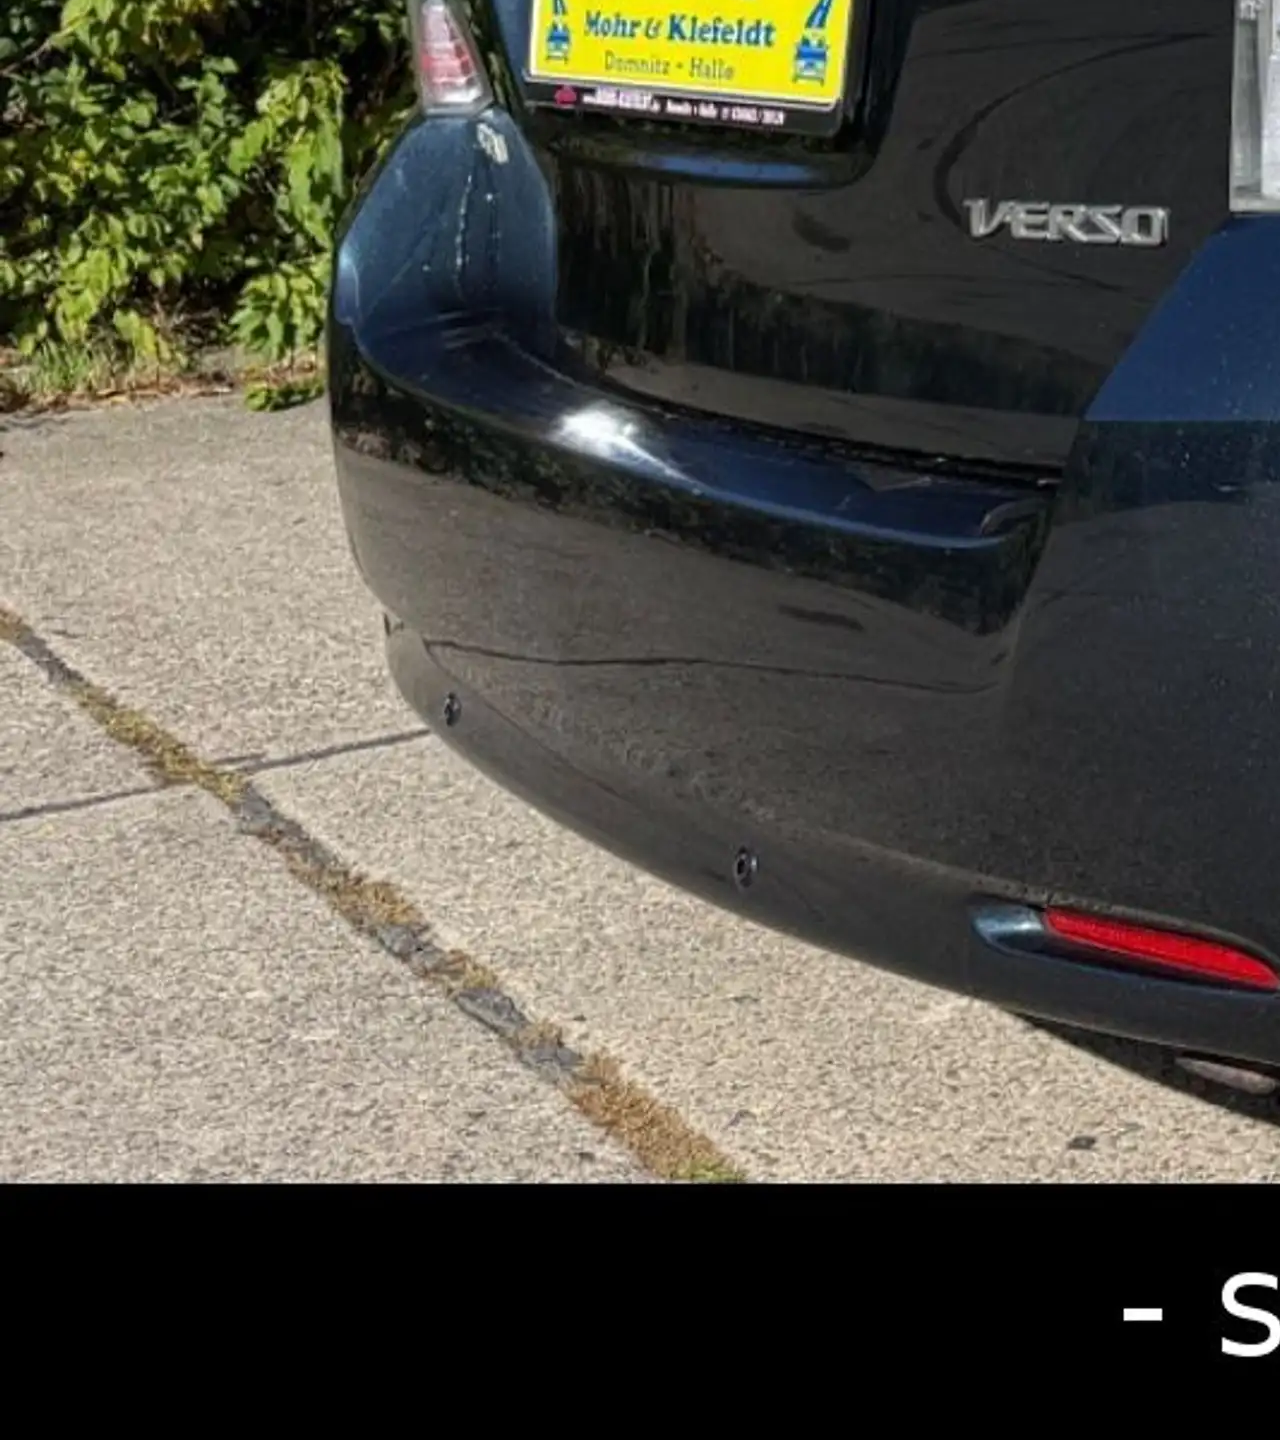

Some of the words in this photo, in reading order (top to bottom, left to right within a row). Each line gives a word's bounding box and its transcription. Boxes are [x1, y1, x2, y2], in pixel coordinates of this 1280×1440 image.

[584, 9, 641, 39] Mohr
[666, 12, 776, 47] Klefeldt
[963, 198, 1170, 247] VERSO
